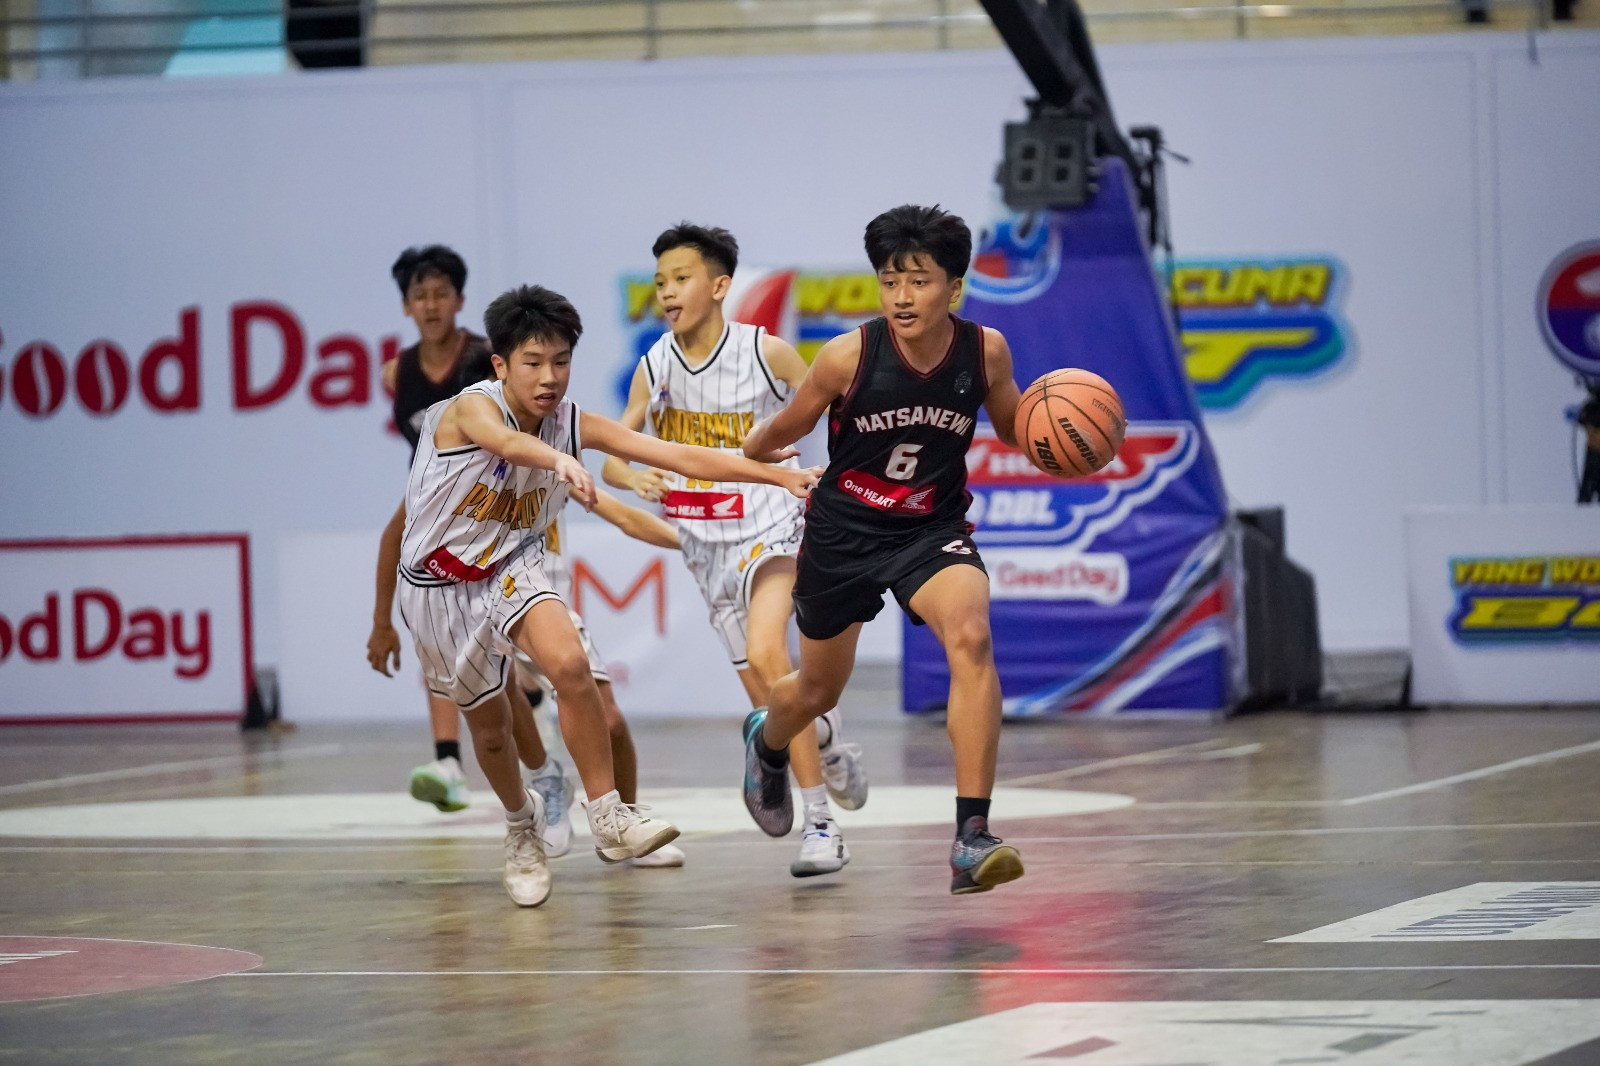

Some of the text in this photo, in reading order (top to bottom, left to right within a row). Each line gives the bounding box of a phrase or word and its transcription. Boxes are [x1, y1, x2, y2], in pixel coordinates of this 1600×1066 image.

[1172, 265, 1332, 306] CUMA
[0, 305, 202, 420] ood
[885, 443, 924, 480] 6
[844, 479, 864, 495] One
[863, 487, 897, 508] HEART
[428, 559, 447, 578] One
[73, 587, 212, 680] Day
